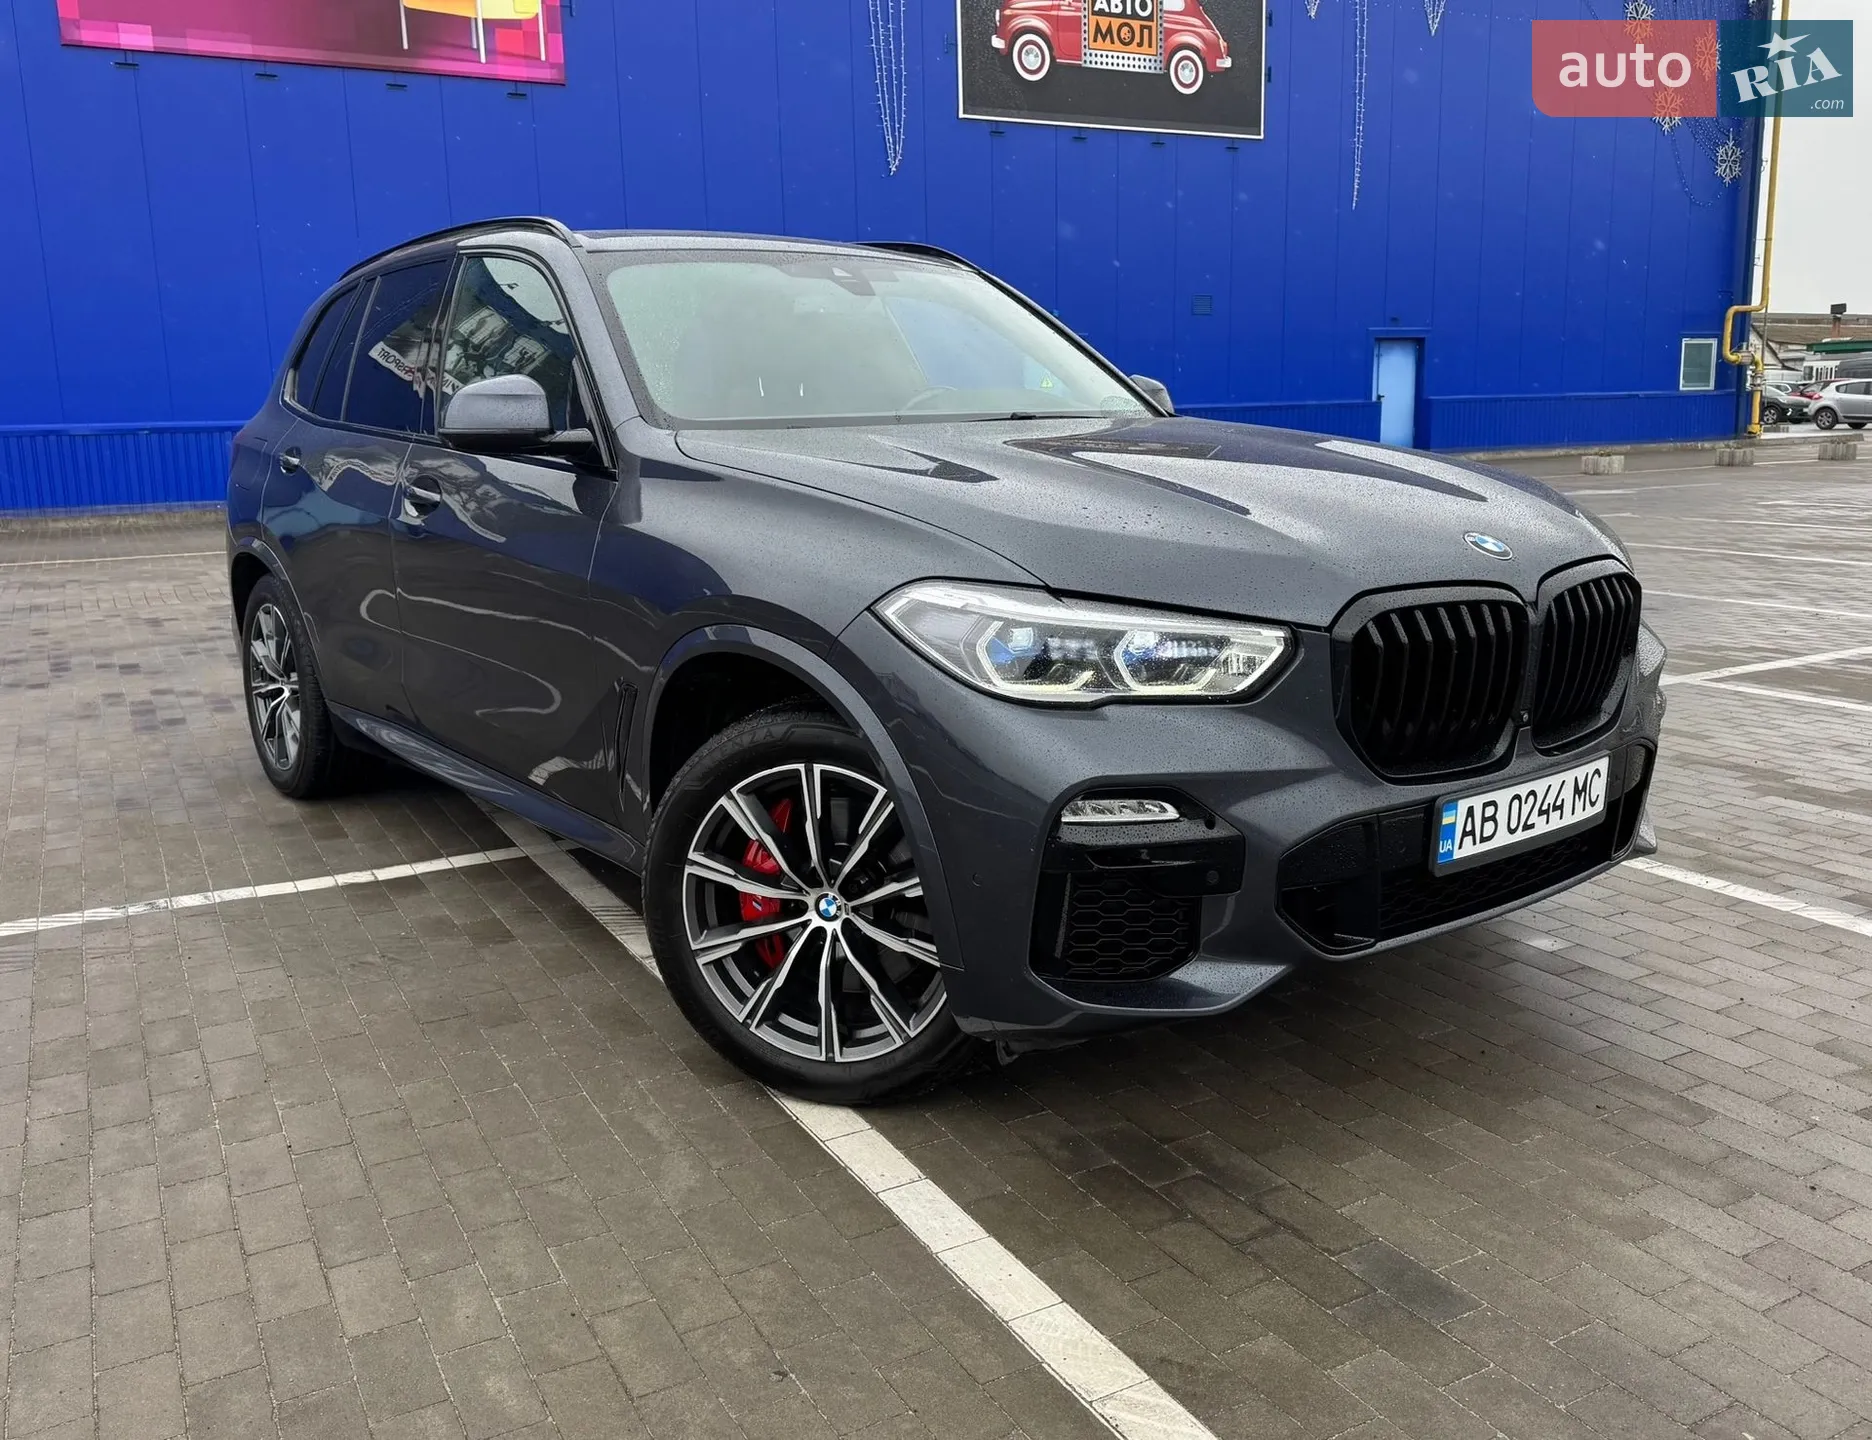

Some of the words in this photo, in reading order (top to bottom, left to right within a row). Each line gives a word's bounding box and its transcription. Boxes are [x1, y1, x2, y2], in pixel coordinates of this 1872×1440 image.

[1093, 19, 1153, 48] МОЛ
[1458, 800, 1499, 850] AB
[1507, 780, 1566, 834] 0244
[1571, 768, 1602, 816] MC
[1439, 838, 1453, 853] UA
